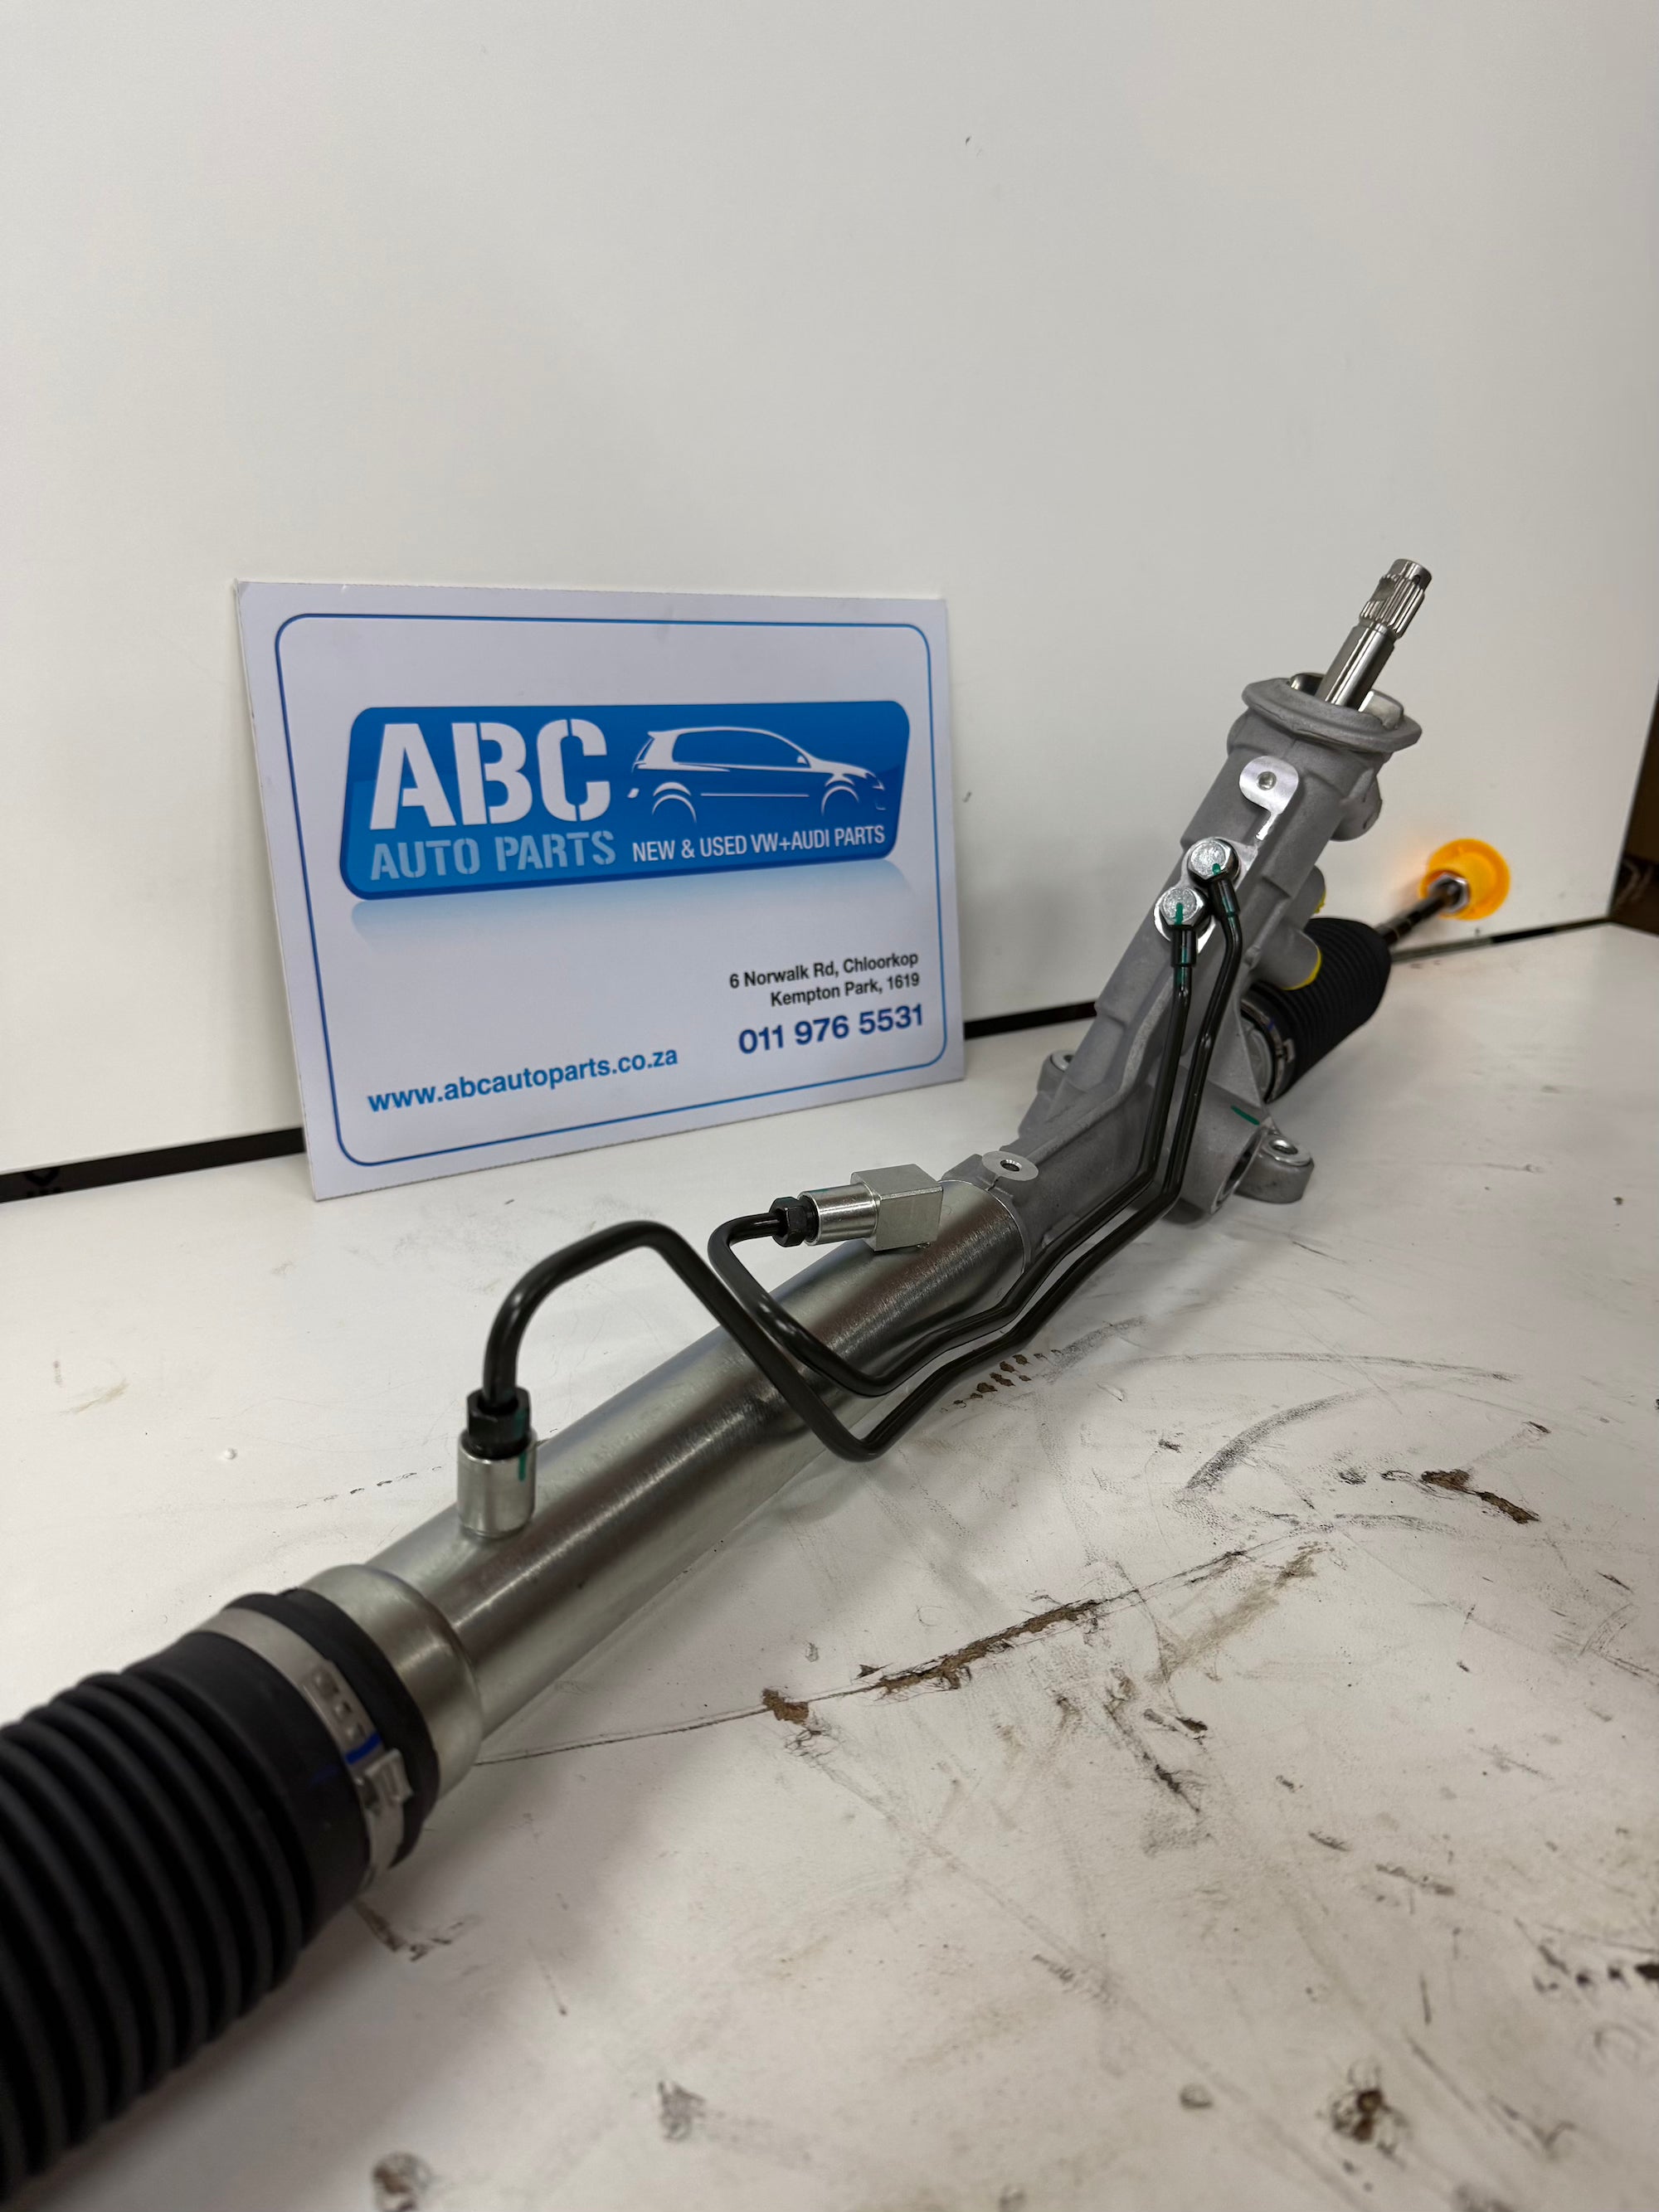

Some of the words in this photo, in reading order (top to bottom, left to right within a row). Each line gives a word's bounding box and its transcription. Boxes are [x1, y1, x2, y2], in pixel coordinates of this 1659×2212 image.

[369, 718, 611, 830] ABC
[370, 838, 481, 881] AUTO
[494, 829, 616, 872] PARTS
[632, 840, 675, 863] NEW
[680, 839, 695, 858] &
[699, 835, 747, 857] USED
[752, 830, 830, 853] VW+AUDI
[834, 825, 885, 847] PARTS
[729, 973, 740, 989] 6
[743, 965, 810, 987] Norwalk
[813, 960, 839, 979] Rd,
[843, 952, 919, 975] Chloorkop
[770, 984, 841, 1007] Kempton
[844, 978, 883, 999] Park,
[887, 972, 920, 991] 1619
[738, 1024, 785, 1054] 011
[794, 1014, 850, 1046] 976
[858, 1004, 923, 1035] 5531
[367, 1048, 679, 1112] www.abcautoparts.co.za
